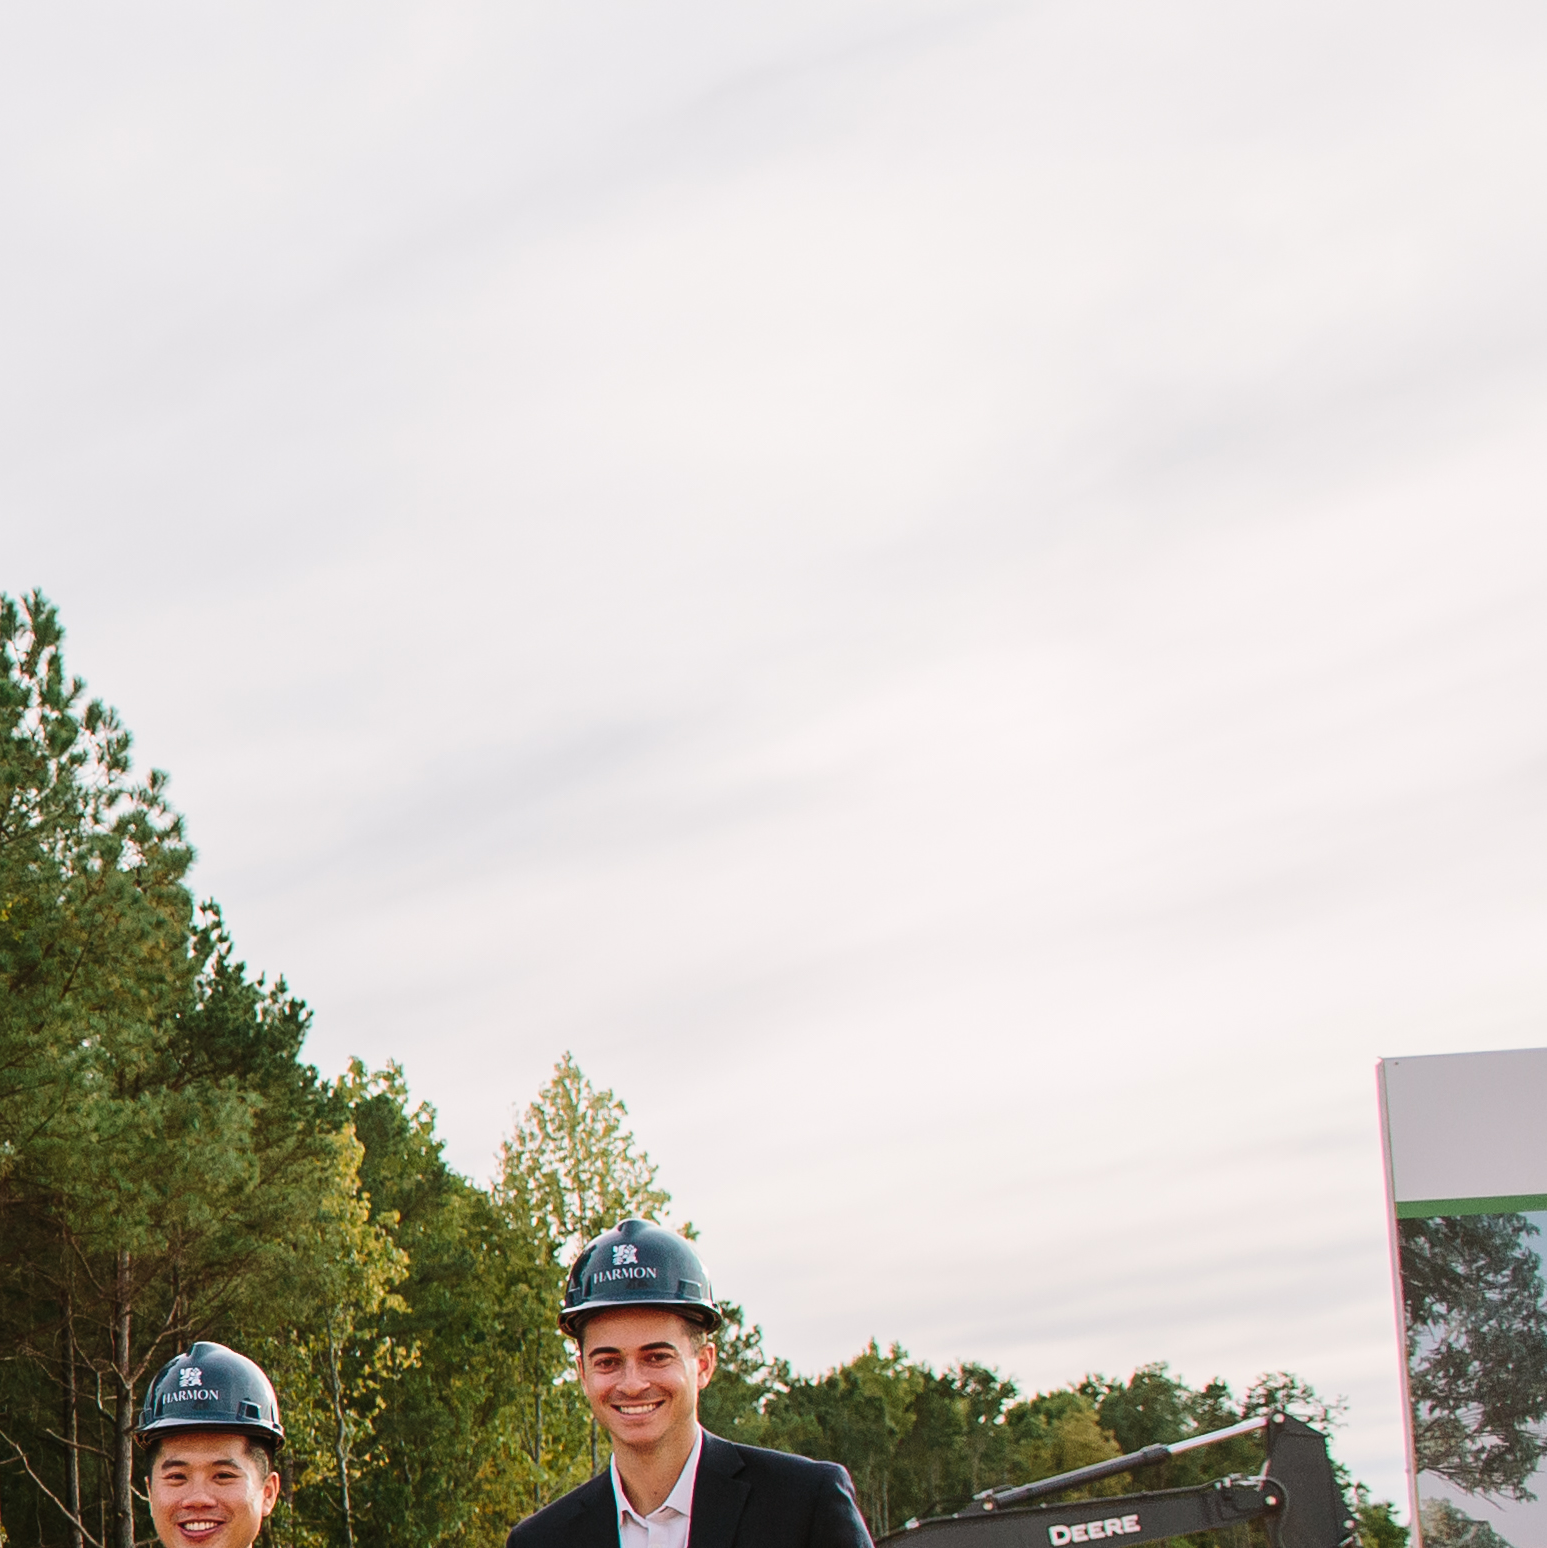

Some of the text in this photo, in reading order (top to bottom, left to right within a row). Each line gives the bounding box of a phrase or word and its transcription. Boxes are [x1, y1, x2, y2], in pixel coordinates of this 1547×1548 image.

[594, 1266, 657, 1284] HARMON
[162, 1389, 219, 1405] HARMON
[1048, 1514, 1142, 1547] DEERE
